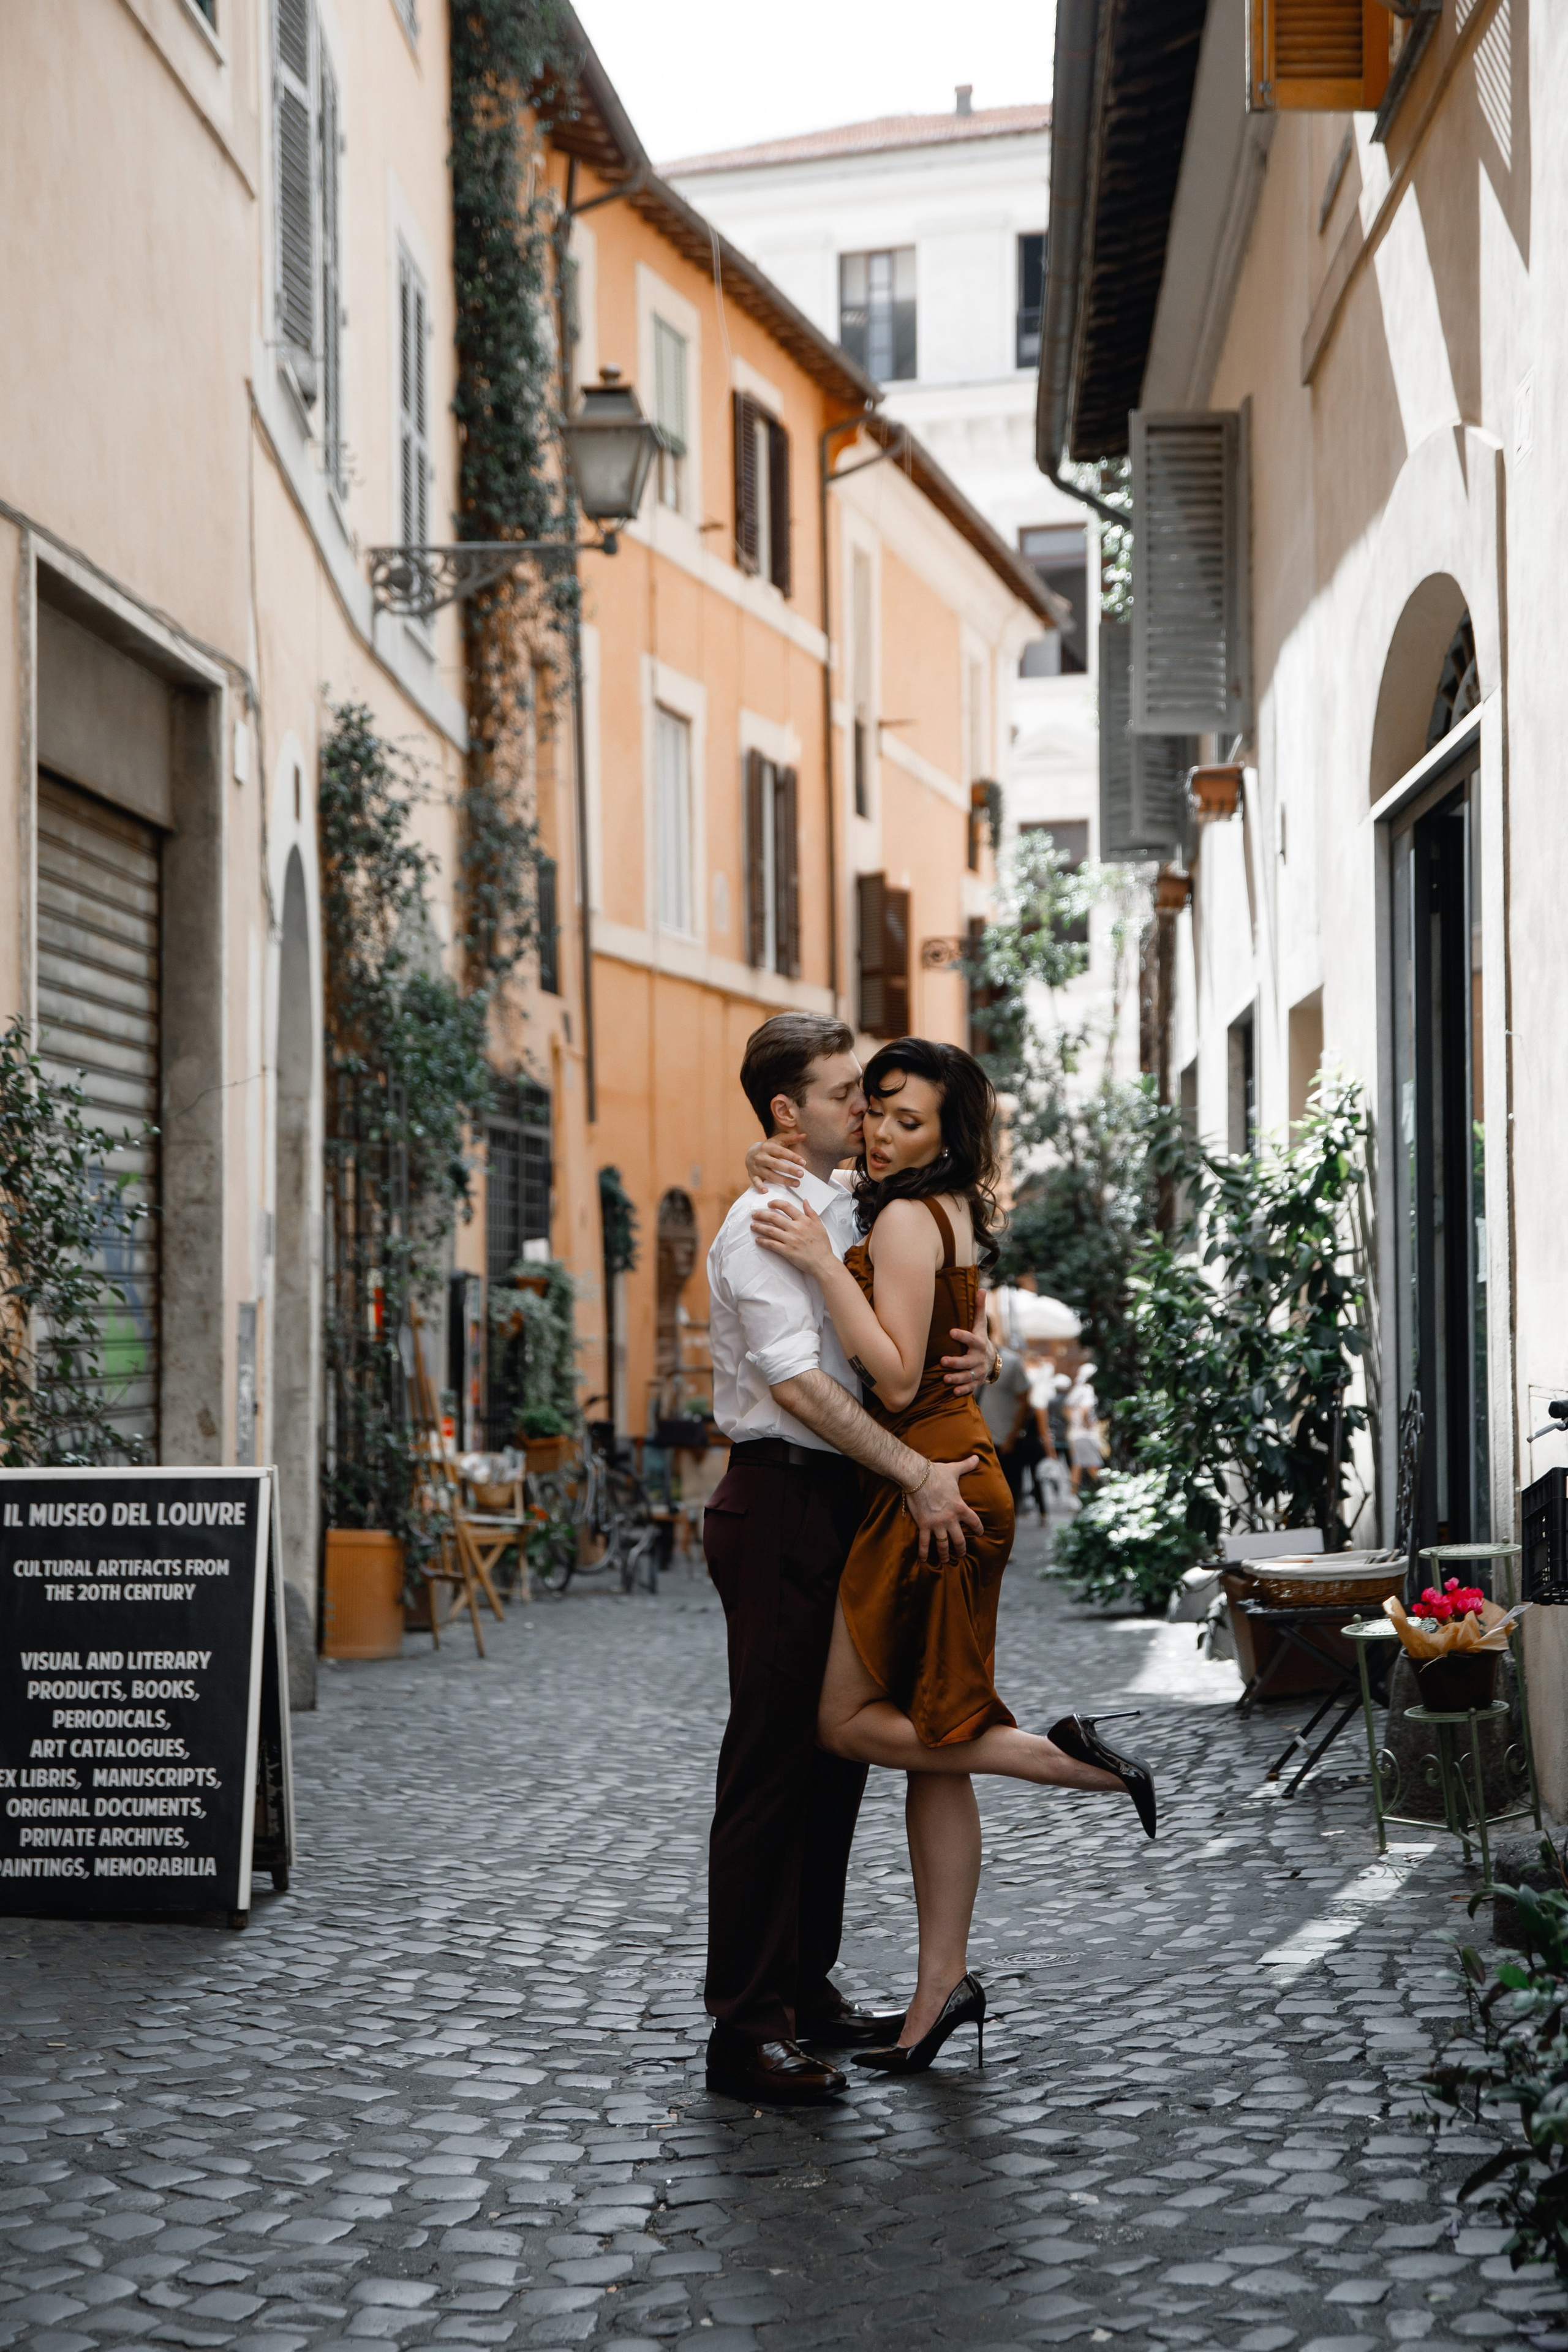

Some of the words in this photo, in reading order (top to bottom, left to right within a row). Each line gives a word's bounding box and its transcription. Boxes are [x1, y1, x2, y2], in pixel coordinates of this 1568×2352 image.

[4, 1504, 23, 1526] IL
[29, 1502, 107, 1526] MUSEO
[111, 1502, 151, 1526] DEL
[157, 1502, 246, 1526] LOUVRE
[13, 1559, 93, 1577] CULTURAL
[96, 1559, 182, 1576] ARTIFACTS
[185, 1559, 230, 1575] FROM
[44, 1585, 74, 1600] THE
[77, 1584, 121, 1600] 20TH
[124, 1583, 196, 1600] CENTURY
[21, 1652, 82, 1670] VISUAL
[86, 1651, 124, 1670] AND
[127, 1651, 212, 1670] LITERARY
[28, 1680, 127, 1702] PRODUCTS,
[132, 1680, 200, 1701] BOOKS,
[53, 1709, 171, 1730] PERIODICALS,
[30, 1739, 67, 1757] ART
[70, 1738, 190, 1759] CATALOGUES,
[20, 1768, 81, 1790] LIBRIS,
[93, 1768, 222, 1789] MANUSCRIPTS,
[7, 1798, 90, 1817] ORIGINAL
[94, 1797, 206, 1819] DOCUMENTS,
[20, 1828, 96, 1847] PRIVATE
[98, 1827, 189, 1849] ARCHIVES,
[0, 1858, 89, 1879] AINTINGS,
[94, 1857, 216, 1876] MEMORABILIA
